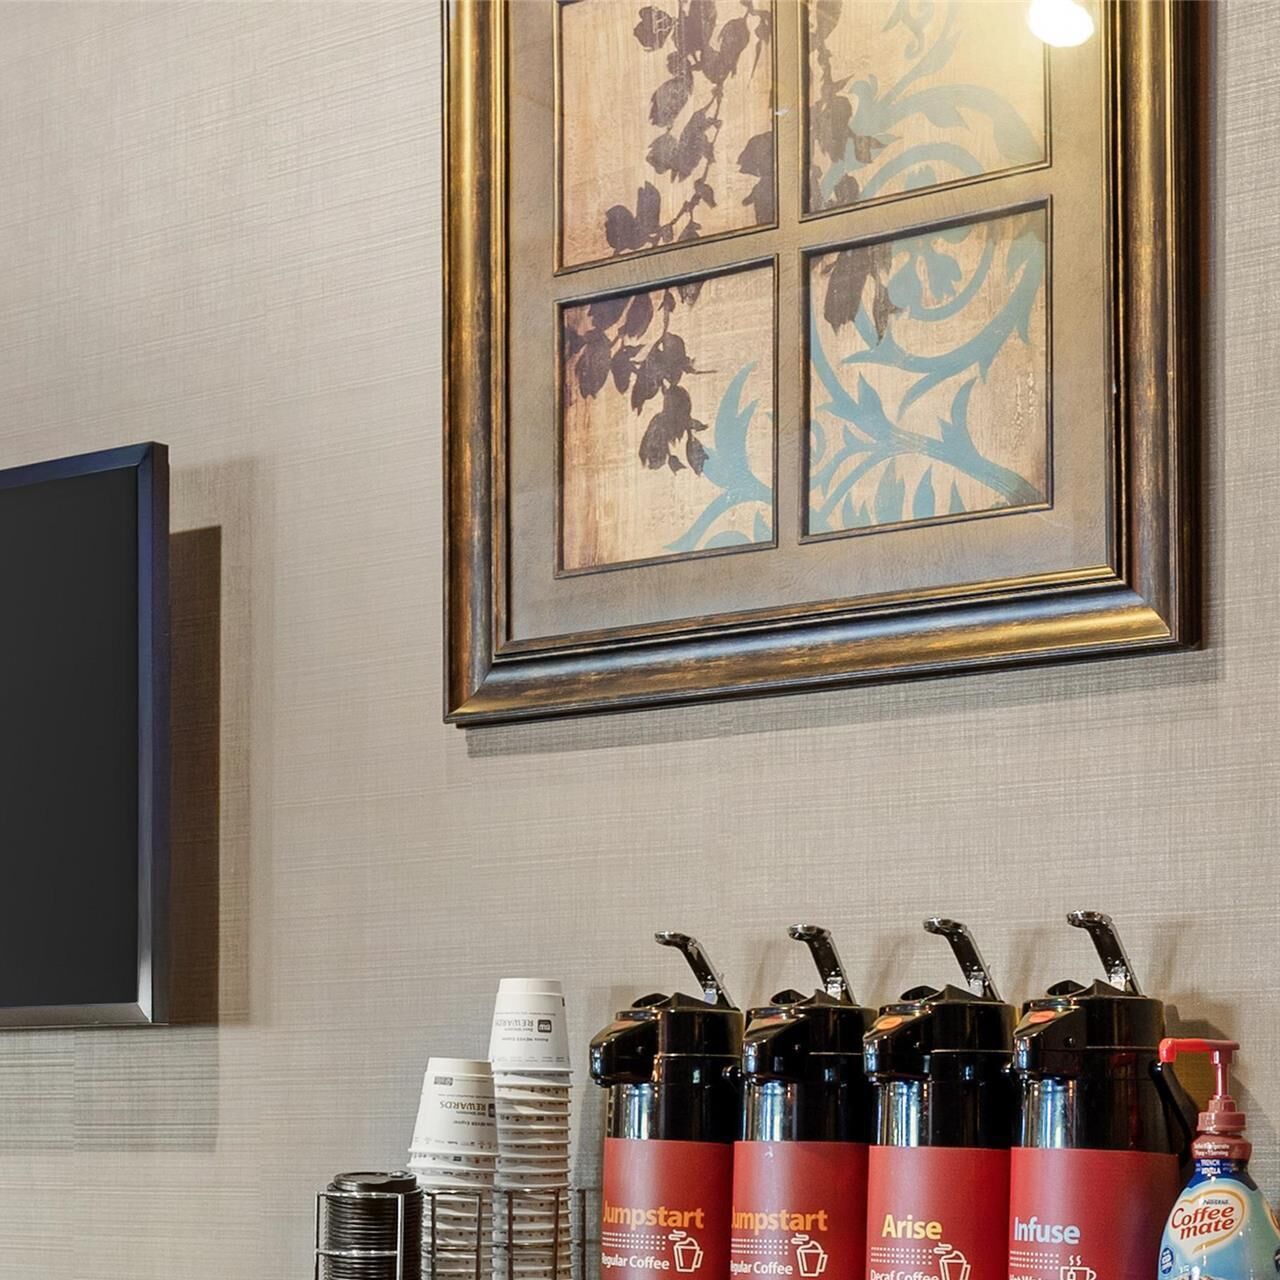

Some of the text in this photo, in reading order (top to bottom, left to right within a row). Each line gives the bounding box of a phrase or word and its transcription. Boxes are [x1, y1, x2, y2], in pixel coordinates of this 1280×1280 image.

[440, 1101, 487, 1111] REWARDS
[881, 1214, 943, 1240] Arise
[1171, 1206, 1235, 1230] Coffee
[1180, 1217, 1235, 1240] mate
[1014, 1216, 1081, 1245] Infuse
[629, 1255, 670, 1270] Coffee
[753, 1261, 794, 1276] Coffee
